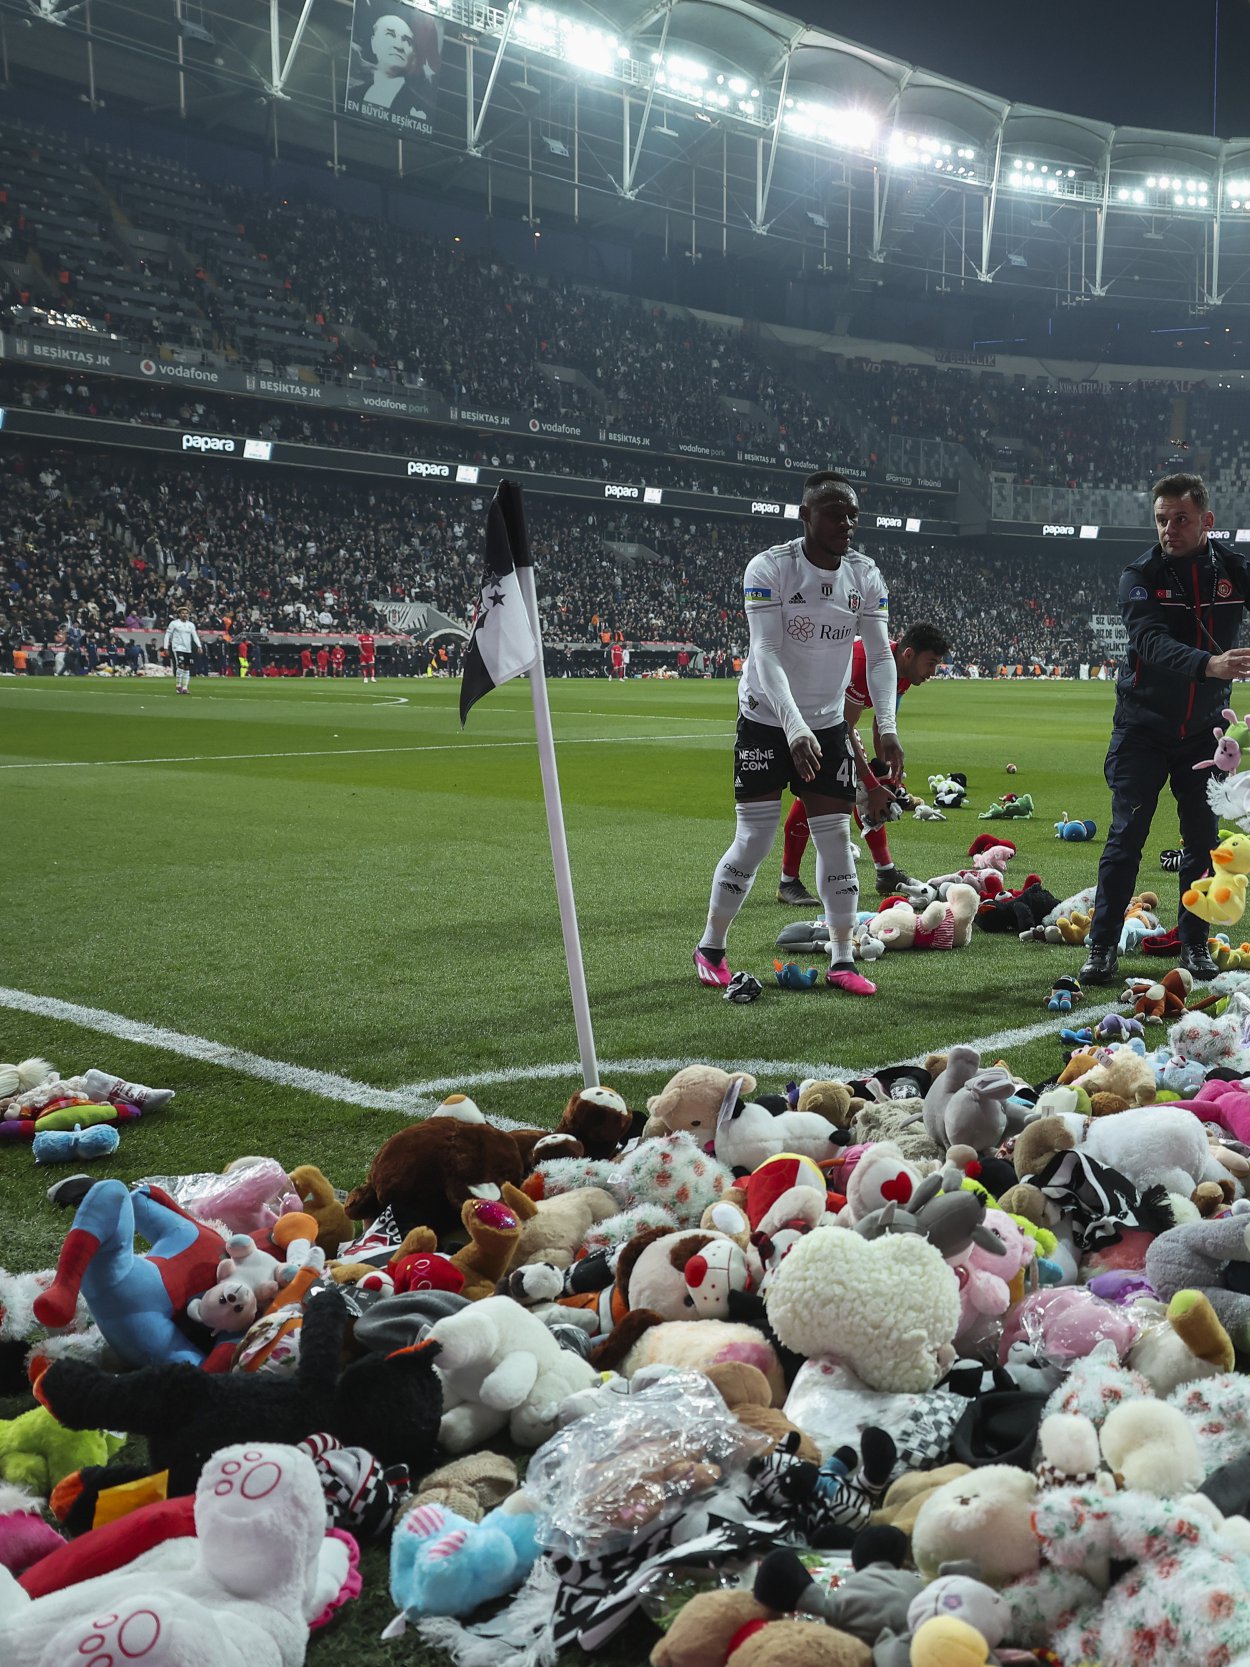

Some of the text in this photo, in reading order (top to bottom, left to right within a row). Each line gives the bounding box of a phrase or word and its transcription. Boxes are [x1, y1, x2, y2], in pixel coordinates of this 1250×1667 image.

[348, 100, 433, 134] EN BÜYÜK BEŞİKTAŞLI
[33, 344, 111, 367] BEŞİKTAŞ JK
[158, 364, 219, 383] vodafone
[259, 380, 321, 398] BEŞİKTAŞ JK
[363, 397, 429, 414] vodafone park
[461, 410, 511, 426] BEŞİKTAŞ JK
[541, 422, 581, 436] vodafone
[182, 434, 235, 452] papara
[608, 432, 650, 446] BEŞİKTAŞ JK
[678, 443, 710, 455] vodafone
[407, 461, 450, 477] papara
[792, 460, 819, 470] vodafone
[860, 470, 867, 478] JK
[604, 484, 639, 498] papara
[751, 501, 780, 515] papara
[876, 516, 902, 529] papara
[1042, 525, 1075, 536] papara
[1207, 530, 1230, 542] para
[740, 761, 769, 771] .COM
